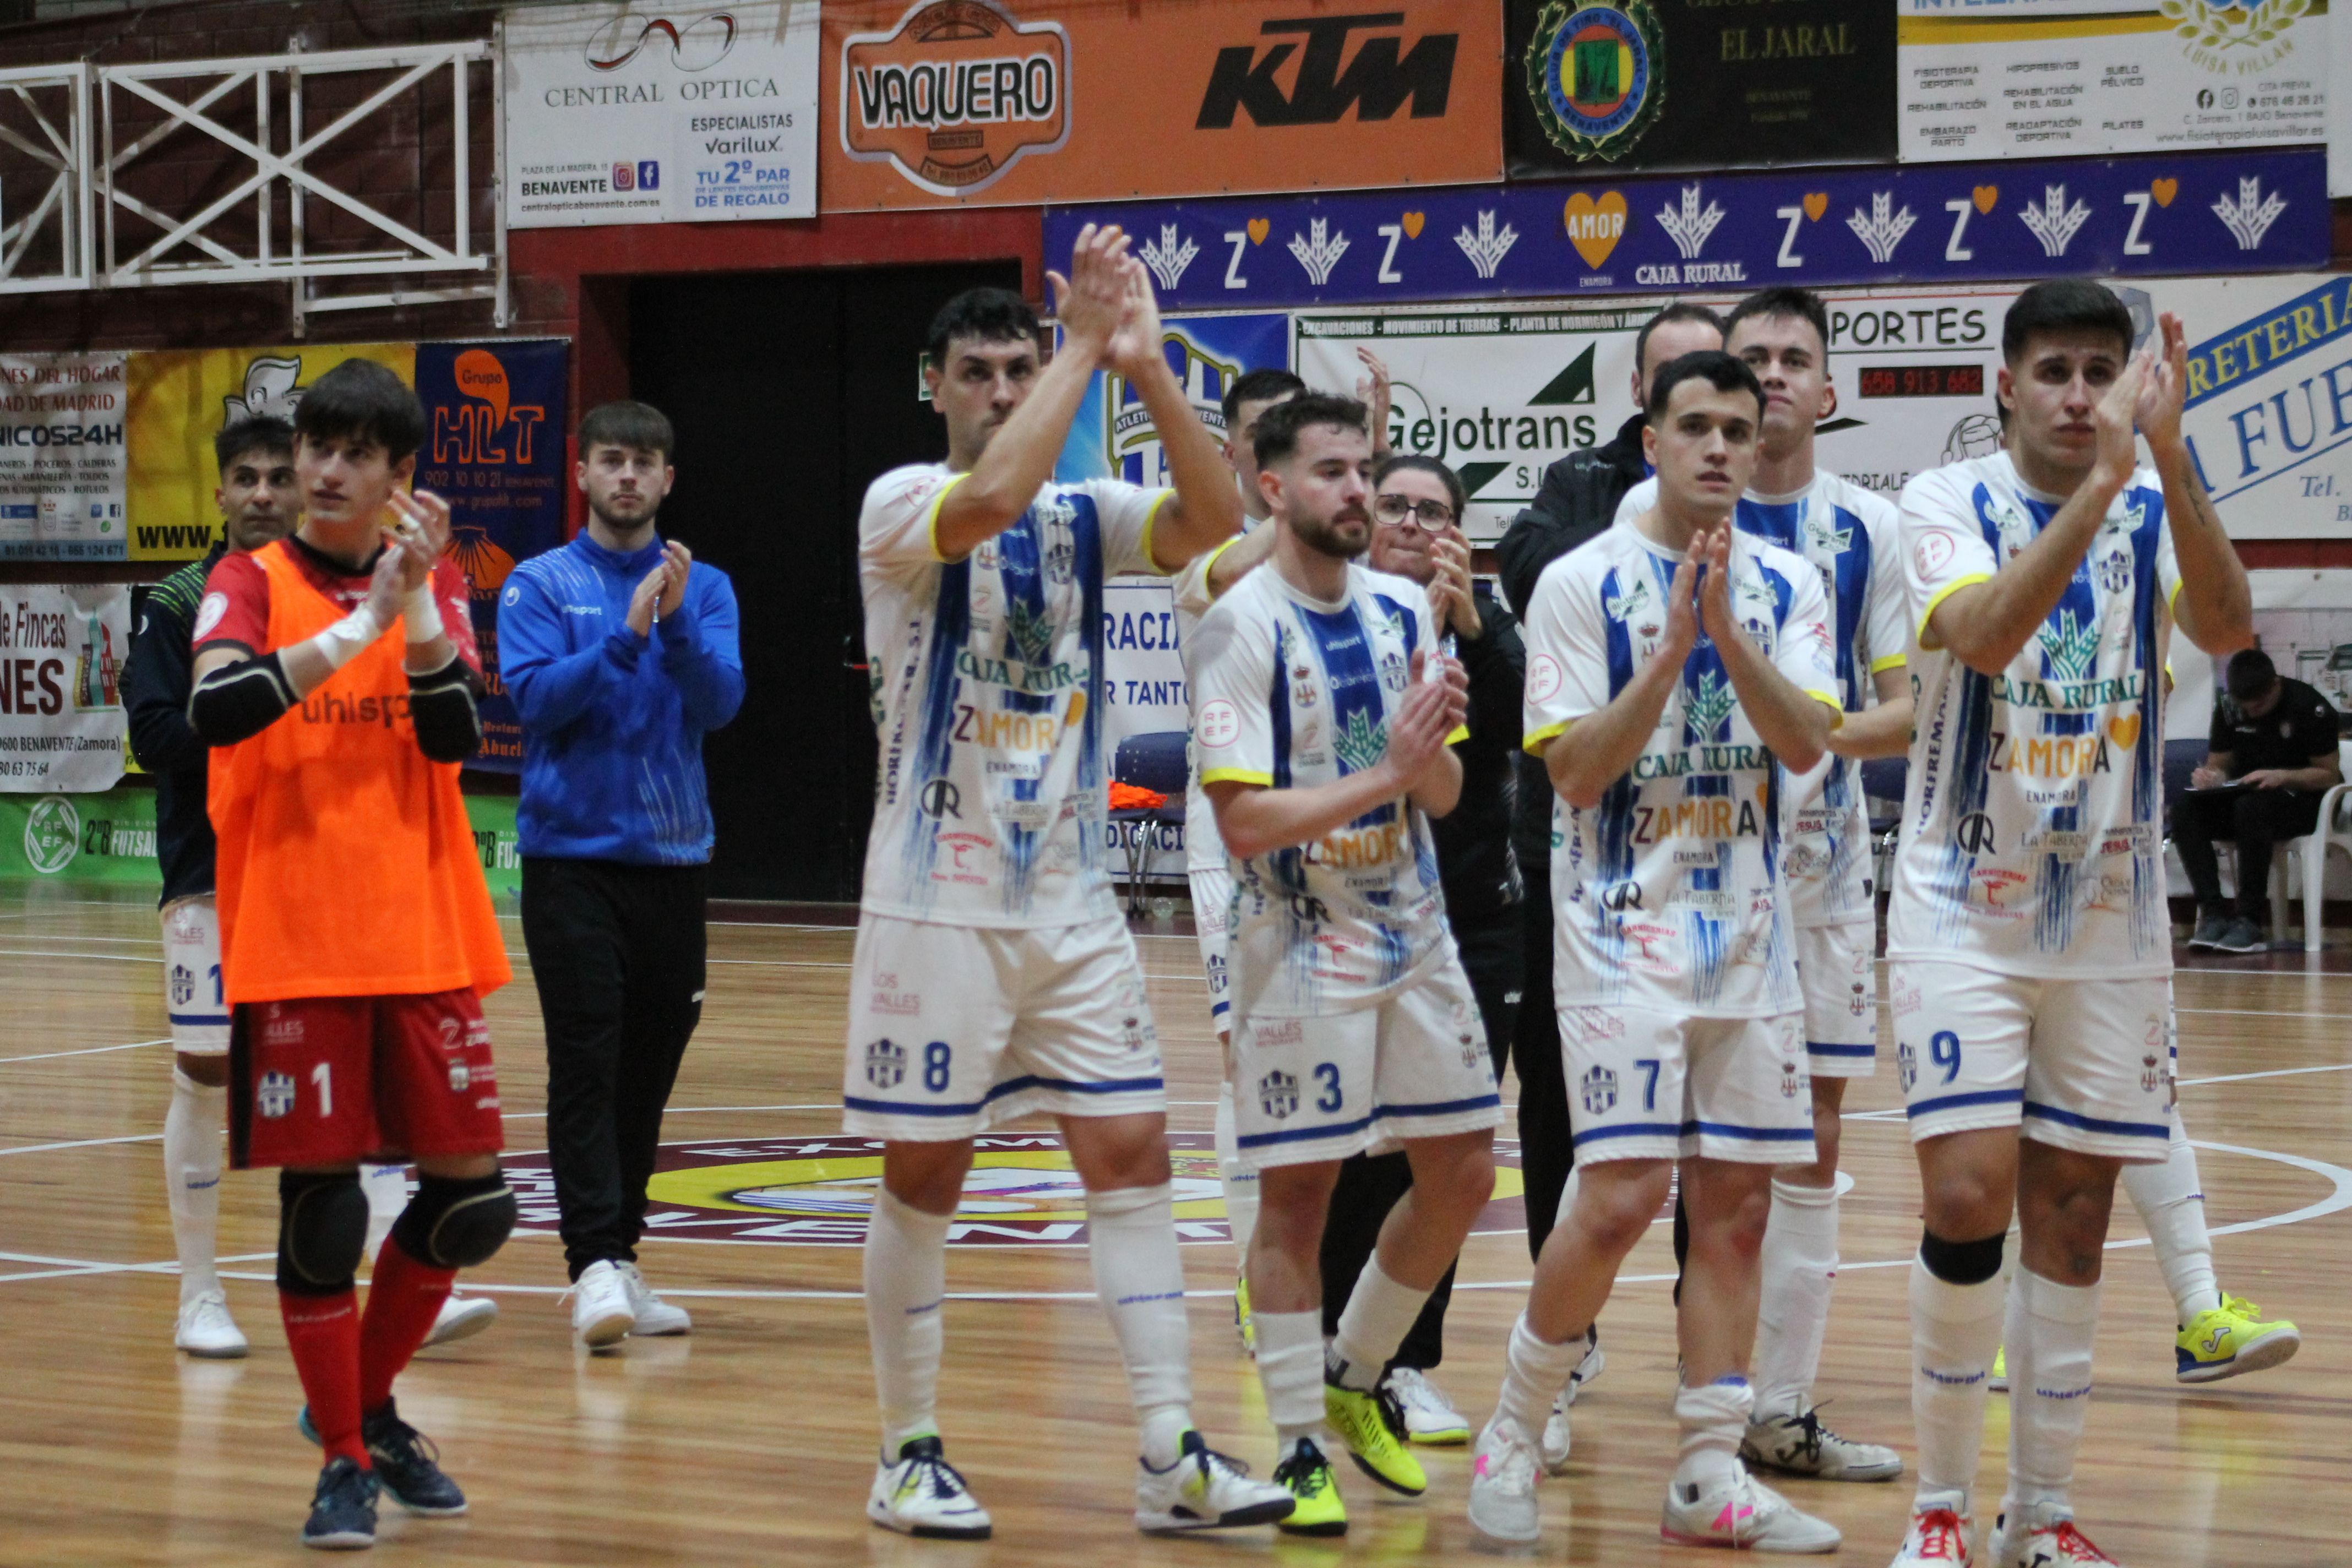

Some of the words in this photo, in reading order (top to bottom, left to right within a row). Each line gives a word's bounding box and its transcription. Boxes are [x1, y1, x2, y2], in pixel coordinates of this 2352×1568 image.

[1721, 29, 1756, 61] EL
[1761, 23, 1859, 58] JARAL
[2183, 42, 2227, 74] LUISA
[2237, 39, 2294, 75] VILLAR
[1195, 12, 1459, 129] KTM
[1913, 66, 1979, 78] FISIOTERAPIA
[2006, 62, 2079, 73] HIPOPRESIVOS
[2106, 66, 2139, 76] SUELO
[1920, 79, 1974, 89] DEPORTIVA
[2003, 84, 2083, 97] REHABILITACIÓN
[2101, 77, 2144, 88] PÉLVICO
[545, 83, 663, 107] CENTRAL
[680, 78, 779, 101] OPTICA
[855, 53, 1055, 131] VAQUERO
[1907, 99, 1986, 112] REHABILITACIÓN
[2013, 101, 2027, 110] EN
[2029, 100, 2041, 109] EL
[2045, 99, 2073, 107] AGUA
[692, 115, 793, 132] ESPECIALISTAS
[2006, 118, 2082, 130] READAPTACIÓN
[2102, 120, 2143, 130] PILATES
[2246, 112, 2271, 122] BAJO
[2274, 110, 2324, 120] Benavente
[1920, 126, 1976, 137] EMBARAZO
[2016, 132, 2071, 142] DEPORTIVA
[1931, 138, 1964, 147] PARTO
[568, 164, 597, 172] MADERA
[696, 171, 720, 184] TU
[756, 168, 790, 182] PAR
[521, 179, 607, 197] BENAVENTE
[521, 199, 660, 213] centralopticabenavente.com/es
[696, 195, 718, 208] DE
[724, 193, 790, 206] REGALO
[1569, 213, 1624, 240] AMOR
[1945, 200, 1972, 262] Z
[2124, 193, 2151, 255] Z
[1777, 207, 1803, 268] Z
[1224, 231, 1247, 289] Z
[1378, 226, 1401, 284] Z
[1580, 277, 1613, 288] ENAMORA
[1635, 266, 1678, 285] CAJA
[1684, 264, 1746, 284] RURAL
[1382, 319, 1443, 335] MOVIMIENTO
[1445, 319, 1458, 334] DE
[1459, 317, 1500, 333] TIERRAS
[1510, 317, 1545, 331] PLANTA
[1547, 316, 1560, 330] DE
[1561, 314, 1615, 330] HORMIGÓN
[1616, 314, 1624, 328] Y
[1831, 308, 1986, 346] PORTES
[34, 367, 62, 384] DEL
[67, 365, 121, 383] HOGAR
[462, 369, 503, 386] Grupo
[29, 395, 46, 412] DE
[53, 394, 115, 412] MADRID
[433, 404, 545, 464] HLT
[78, 459, 116, 468] CALDERAS
[79, 472, 110, 481] TOLDOS
[425, 471, 449, 487] 902
[2300, 475, 2340, 497] Tel.
[17, 601, 66, 649] Fincas
[1103, 612, 1180, 651] RACI
[1992, 675, 2053, 709] CAJA
[2062, 674, 2144, 710] RURAL
[20, 736, 74, 752] BENAVENTE
[74, 735, 121, 753] (Zamora)
[1989, 731, 2111, 778] ZAMORA
[12, 761, 23, 776] 63
[1635, 797, 1758, 845] ZAMORA
[1673, 851, 1713, 864] ENAMORA
[922, 1041, 951, 1093] 8
[1929, 1031, 1961, 1086] 9
[311, 1061, 332, 1119] 1
[1313, 1062, 1343, 1114] 3
[1633, 1059, 1660, 1113] 7
